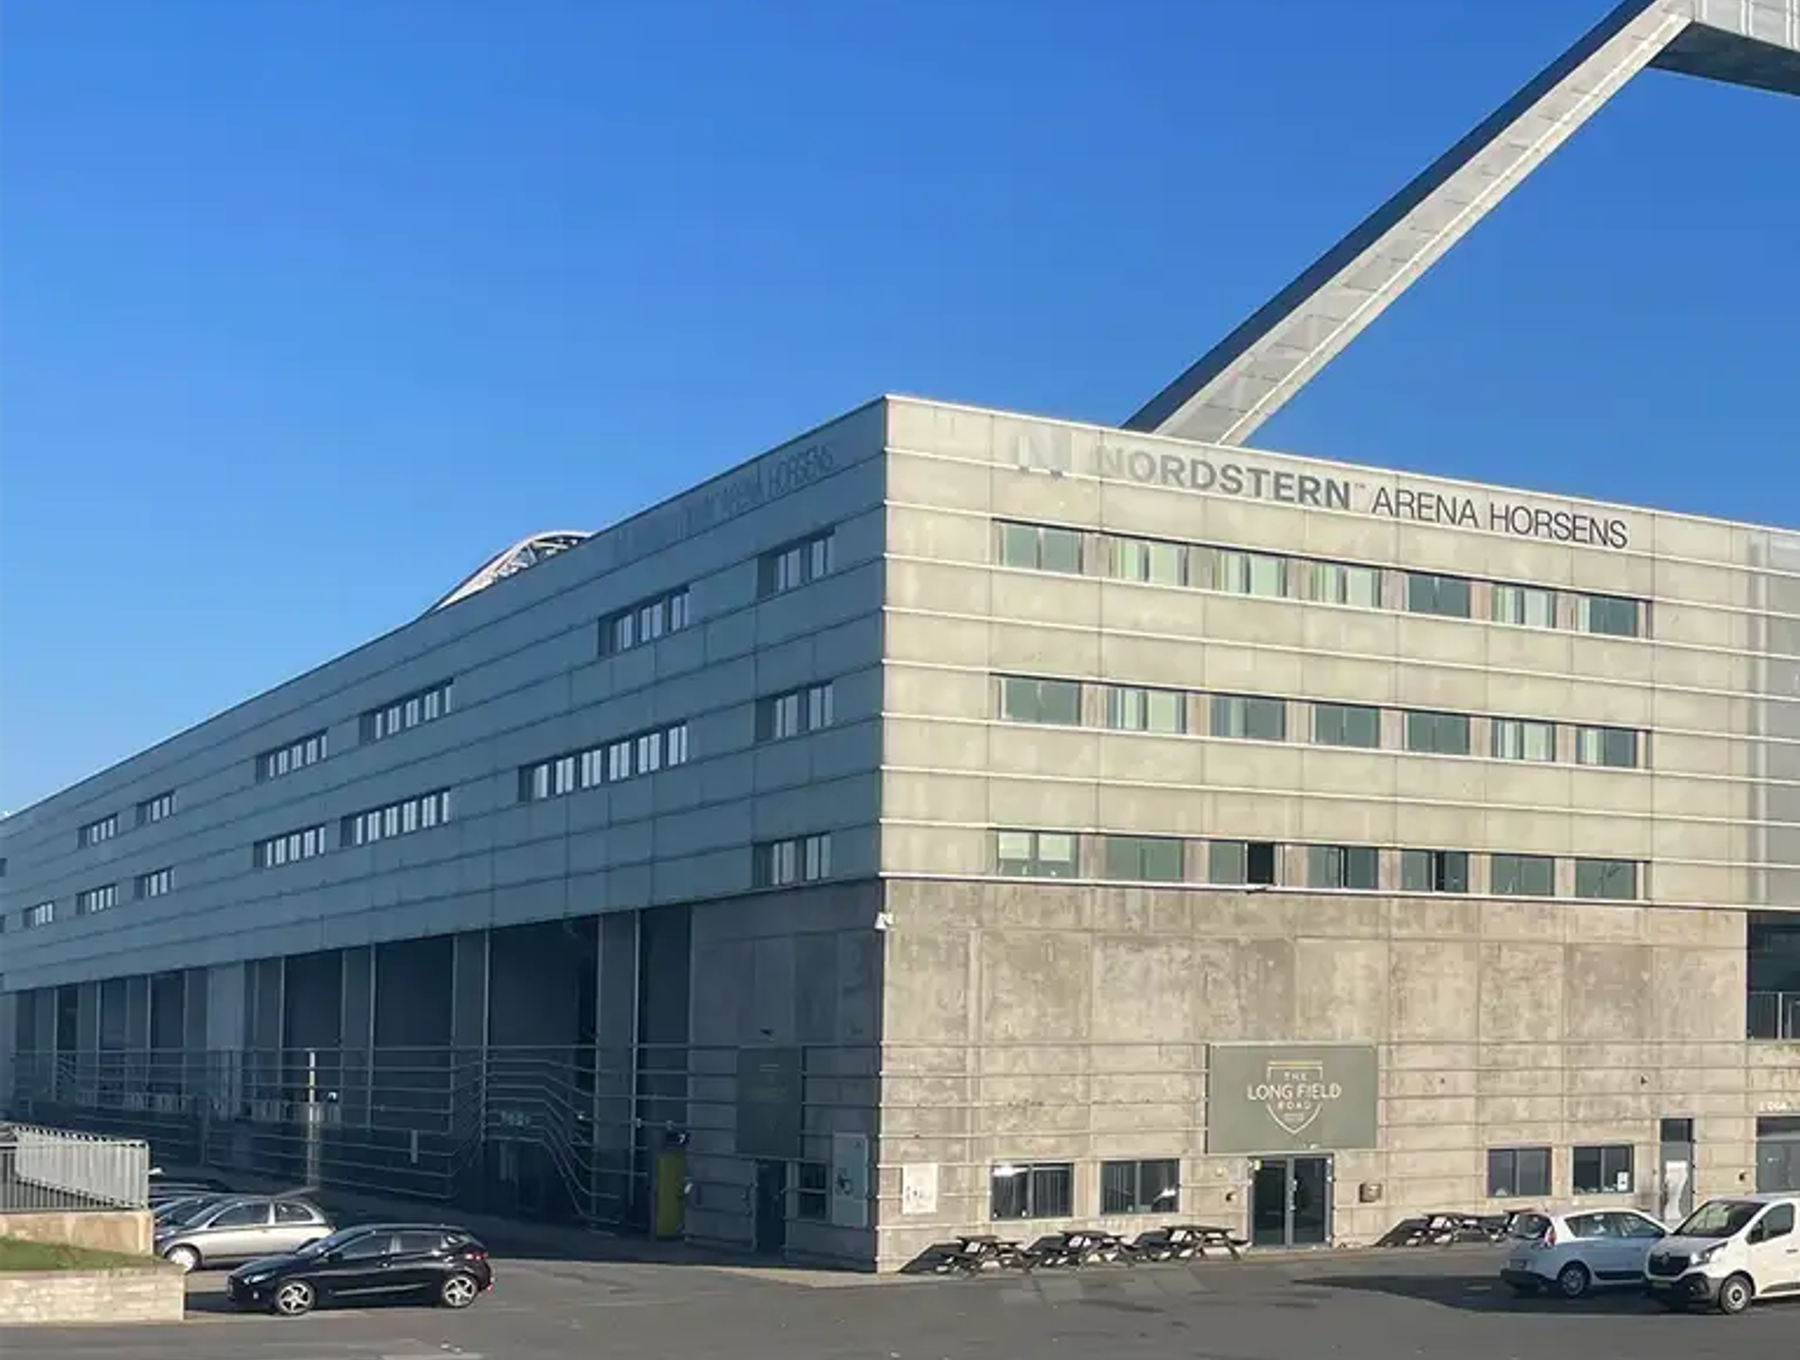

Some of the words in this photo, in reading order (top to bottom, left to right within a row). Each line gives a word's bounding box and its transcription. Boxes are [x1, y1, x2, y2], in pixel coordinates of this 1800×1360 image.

[1092, 444, 1350, 511] NORDSTERN
[1371, 486, 1480, 528] ARENA
[1490, 502, 1629, 549] HORSENS
[1283, 1071, 1308, 1081] THE
[1247, 1083, 1294, 1101] LONG
[1296, 1082, 1342, 1100] FIELD
[1277, 1100, 1312, 1111] ROAD
